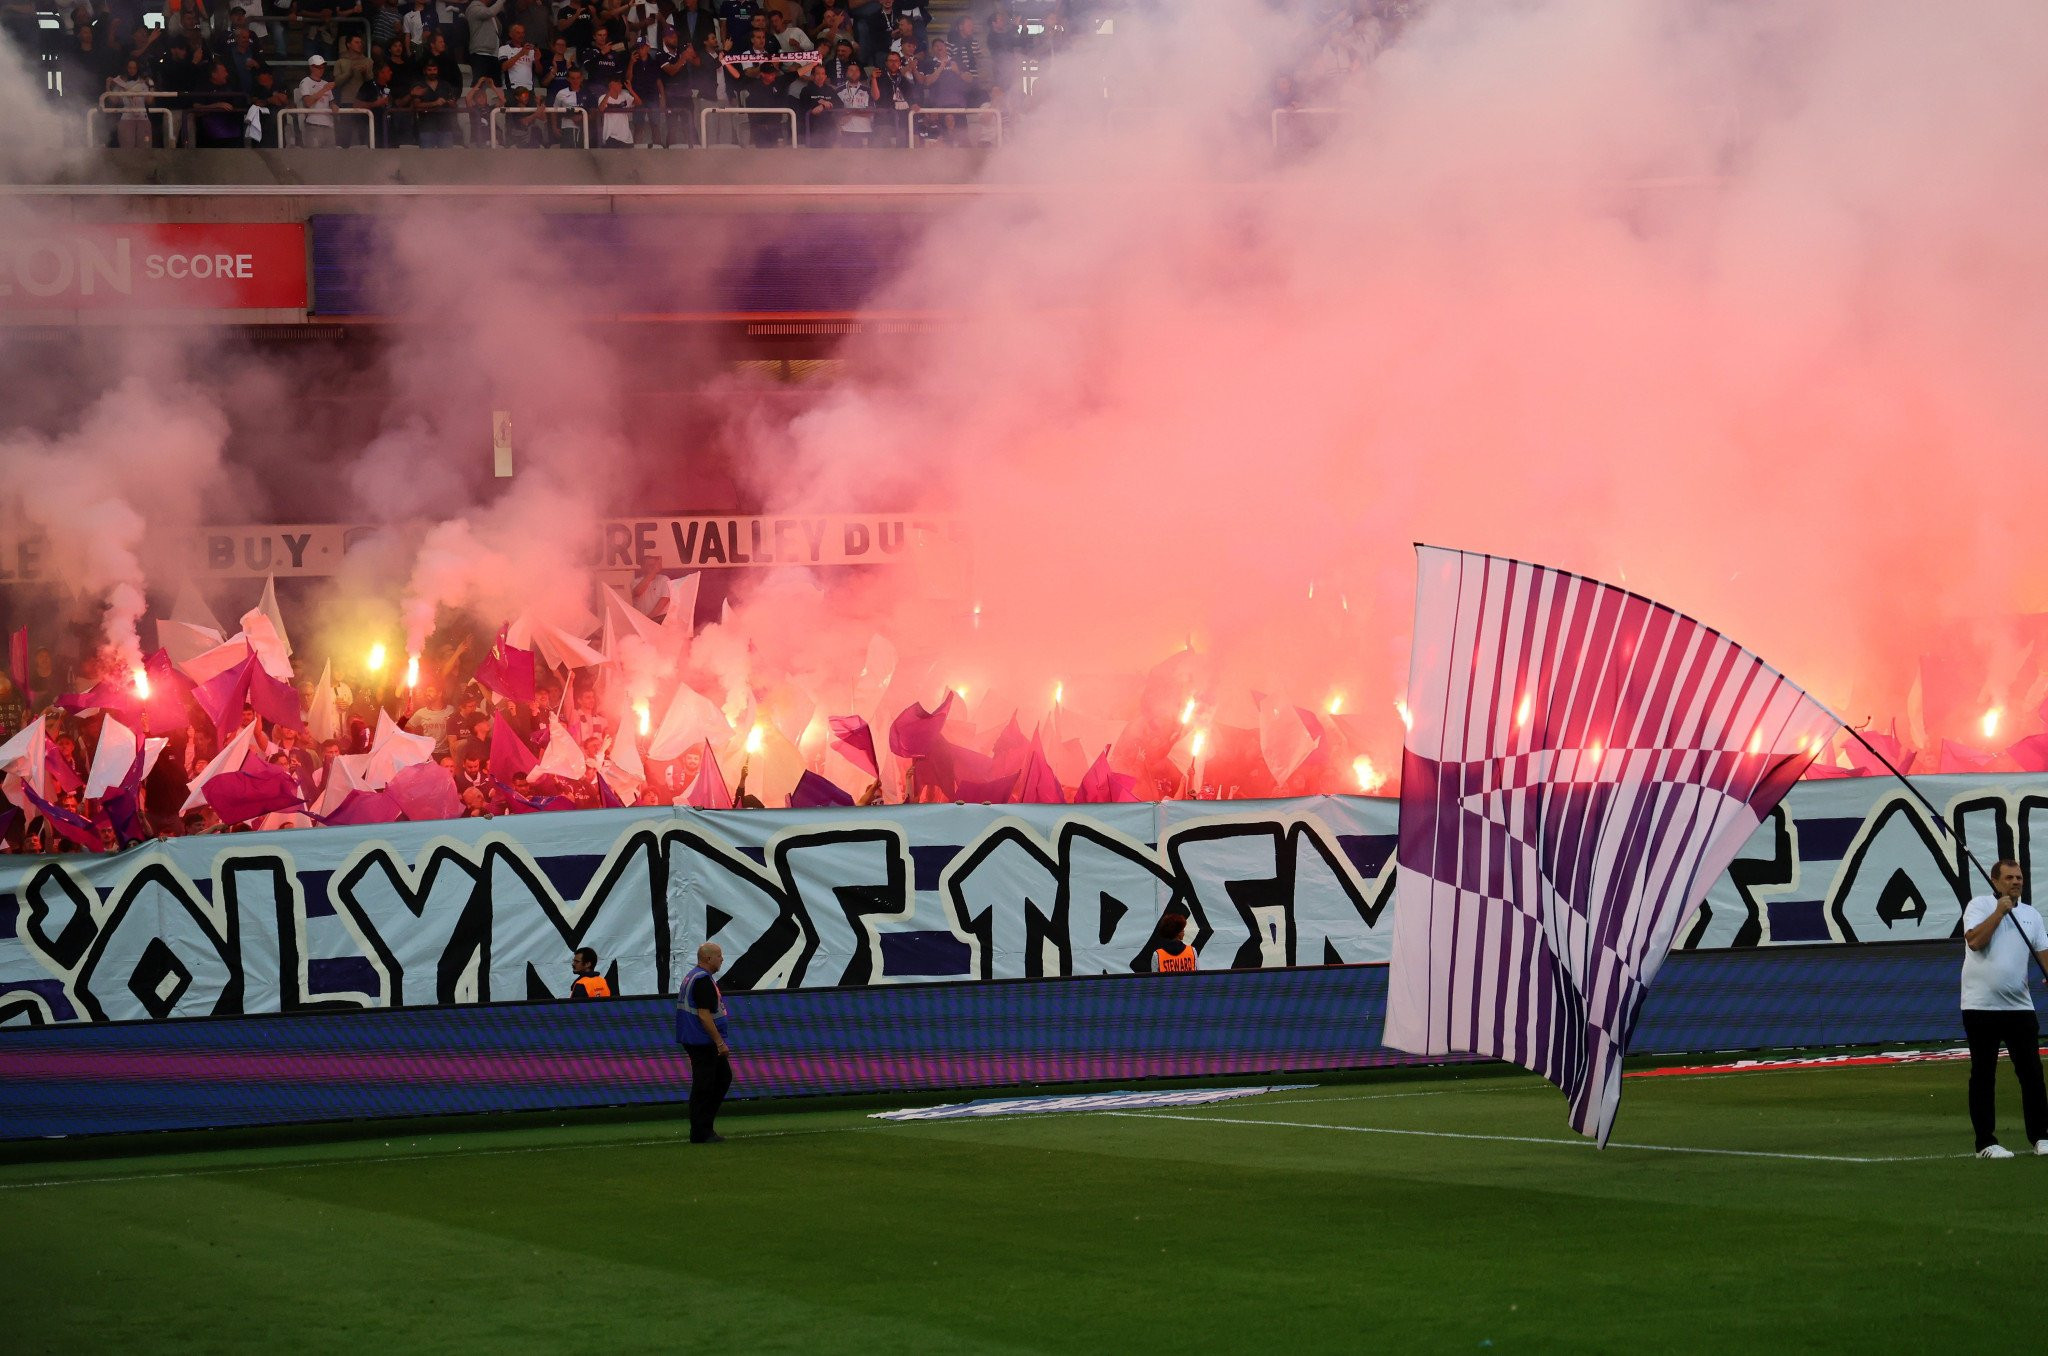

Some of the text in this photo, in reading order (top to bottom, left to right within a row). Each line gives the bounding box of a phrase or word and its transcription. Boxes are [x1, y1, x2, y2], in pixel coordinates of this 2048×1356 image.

[0, 238, 254, 297] ON SCORE
[671, 520, 828, 565] VALLEY
[1163, 958, 1192, 972] STEWARD
